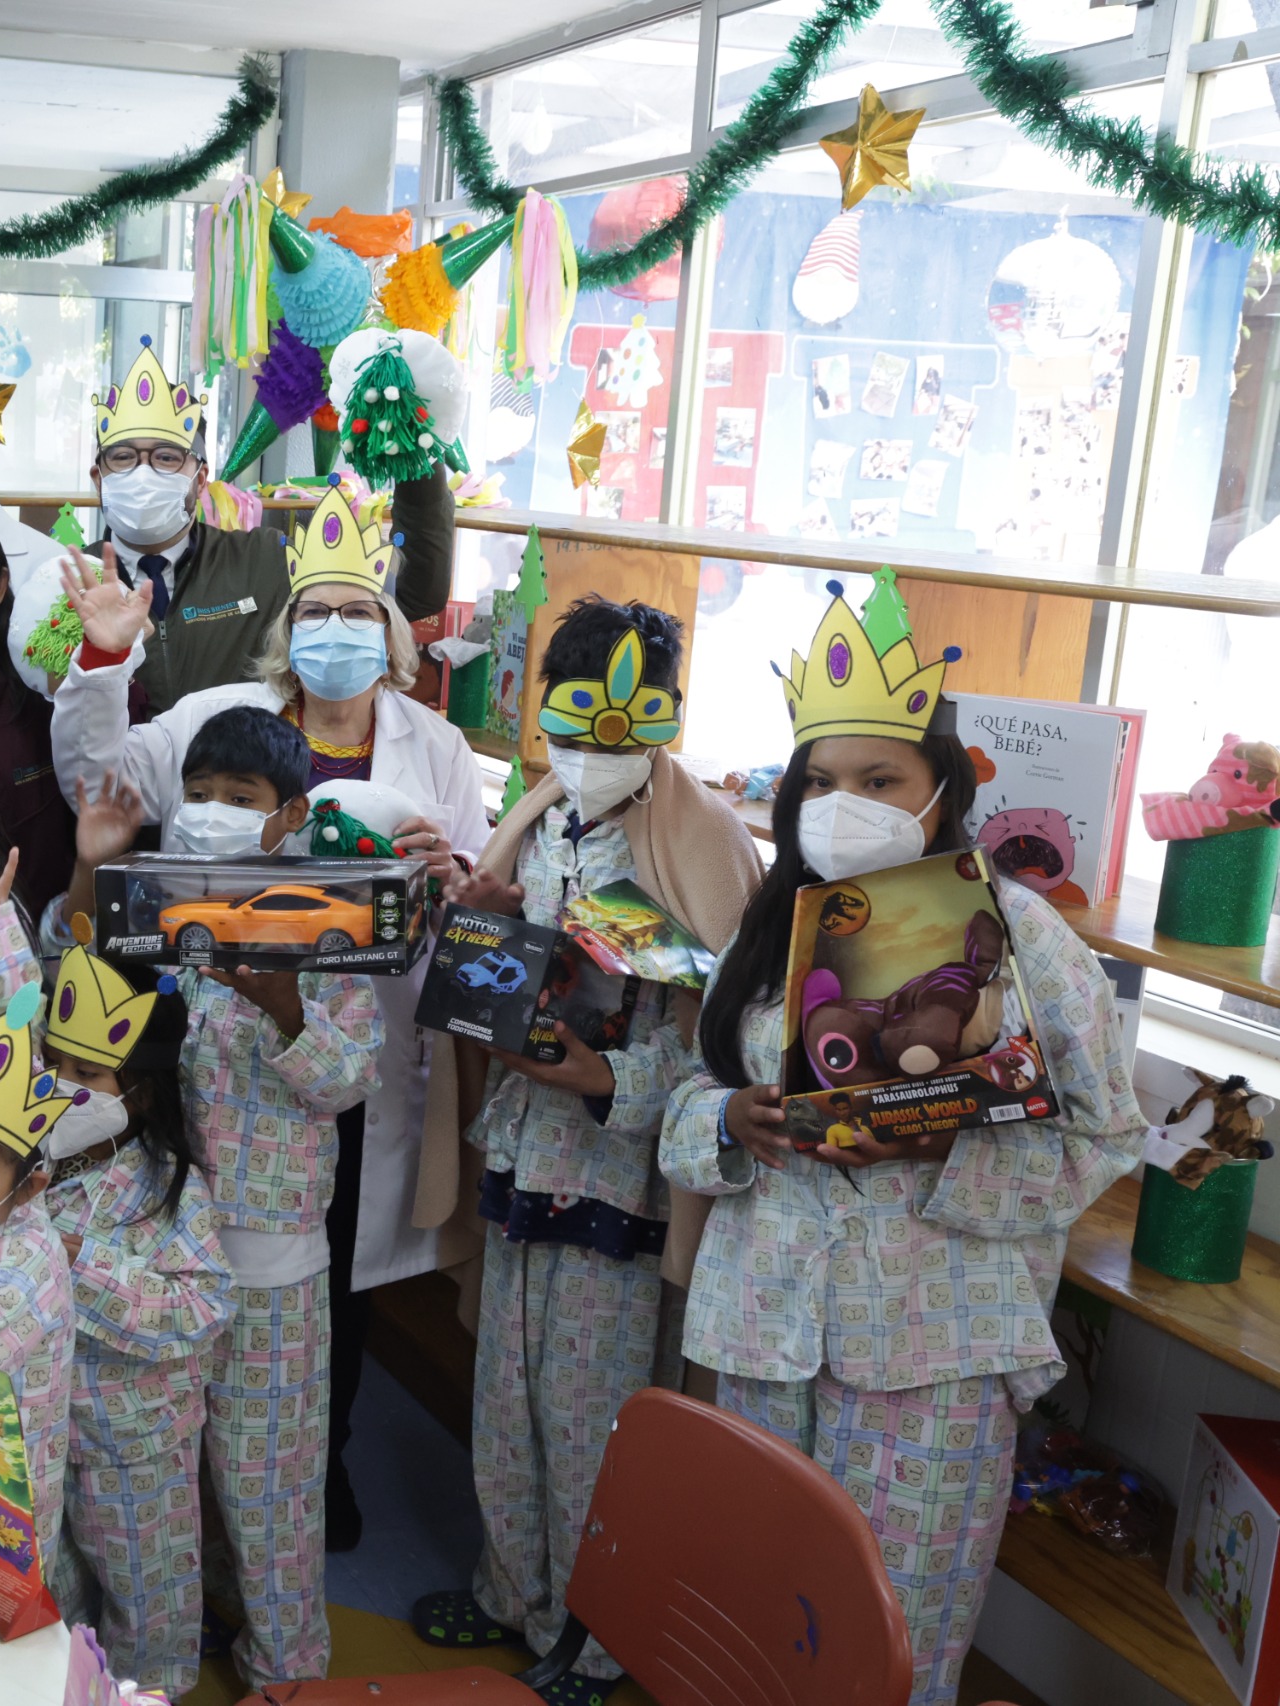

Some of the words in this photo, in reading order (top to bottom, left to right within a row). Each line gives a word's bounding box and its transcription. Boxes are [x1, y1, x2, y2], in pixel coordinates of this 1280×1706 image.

[211, 601, 237, 613] BIENEST
[974, 715, 1018, 737] ¿QUÉ
[1021, 720, 1068, 742] PASA,
[994, 736, 1042, 757] BEBÉ?
[452, 914, 500, 934] MOTOR
[105, 935, 164, 950] ADVENTURE
[445, 926, 504, 948] EXTREME
[586, 932, 620, 961] NINJAGO
[316, 956, 341, 965] FORD
[343, 952, 385, 963] MUSTANG
[387, 951, 398, 959] GT
[449, 1017, 493, 1034] CORREDORES
[536, 1015, 555, 1026] MOTO
[446, 1023, 494, 1042] TODOTERRENO
[872, 1082, 960, 1105] PARASAUROLOPHUS
[869, 1107, 923, 1128] JURASSIC
[923, 1098, 978, 1119] WORLD
[1026, 1102, 1049, 1112] MATTEL
[892, 1122, 924, 1137] CHAOS
[923, 1117, 961, 1133] THEORY
